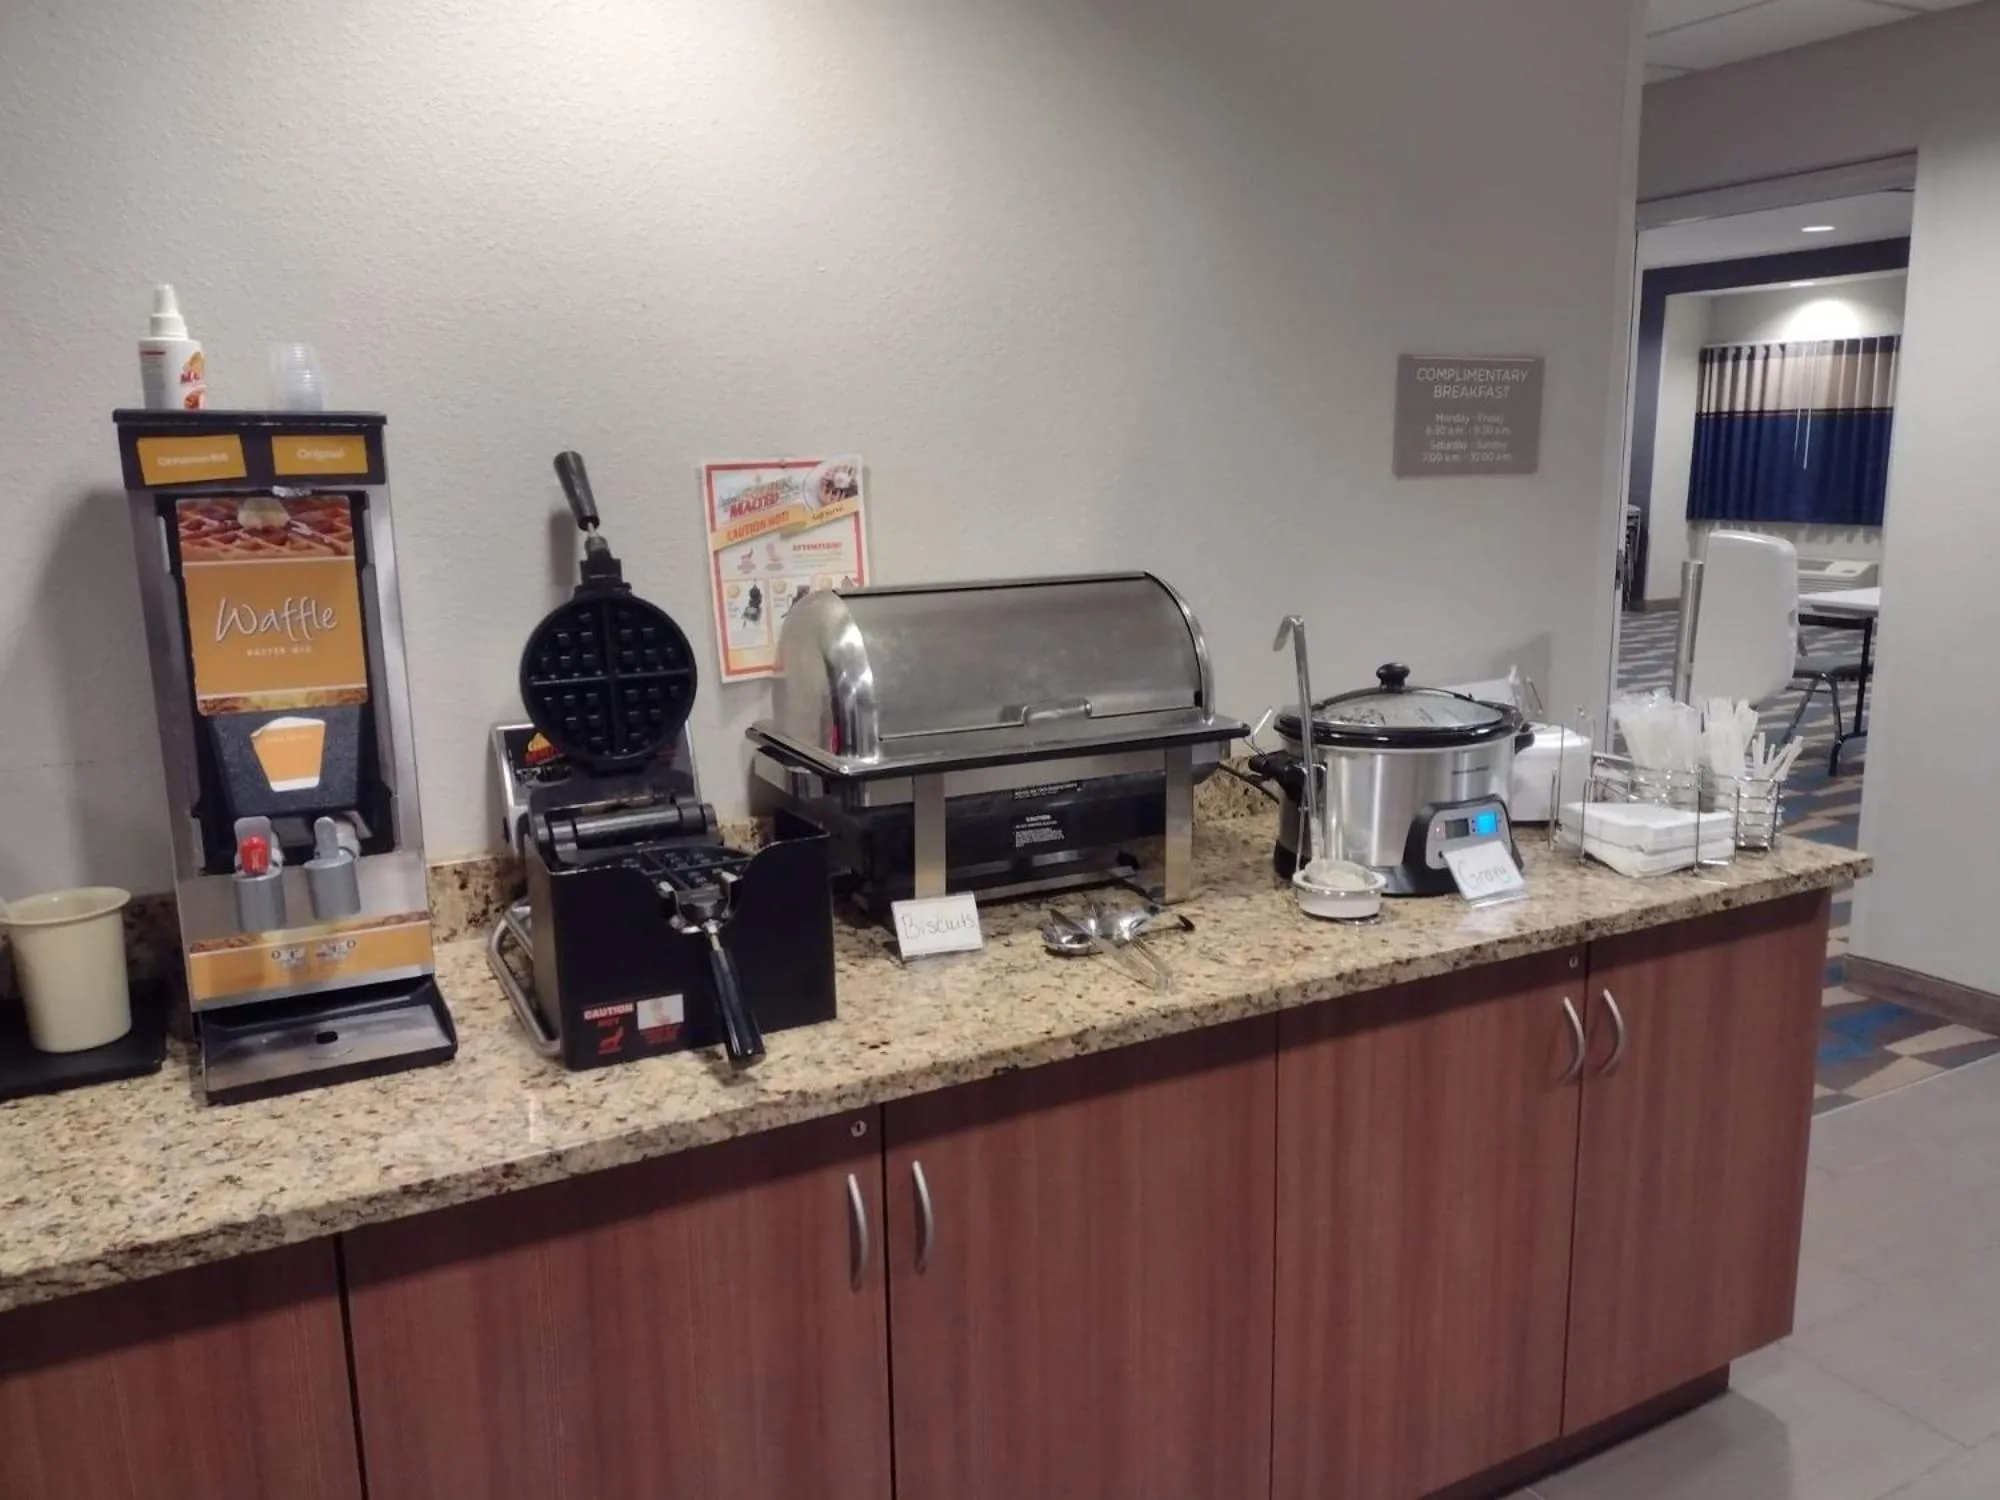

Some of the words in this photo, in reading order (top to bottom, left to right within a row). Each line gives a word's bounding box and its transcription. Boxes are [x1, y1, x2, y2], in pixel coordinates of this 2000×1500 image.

[1416, 367, 1529, 383] COMPLIMENTARY
[1433, 384, 1511, 399] BREAKFAST
[727, 519, 766, 541] CAUTION
[215, 596, 338, 642] Waffle
[583, 1002, 635, 1021] CAUTION
